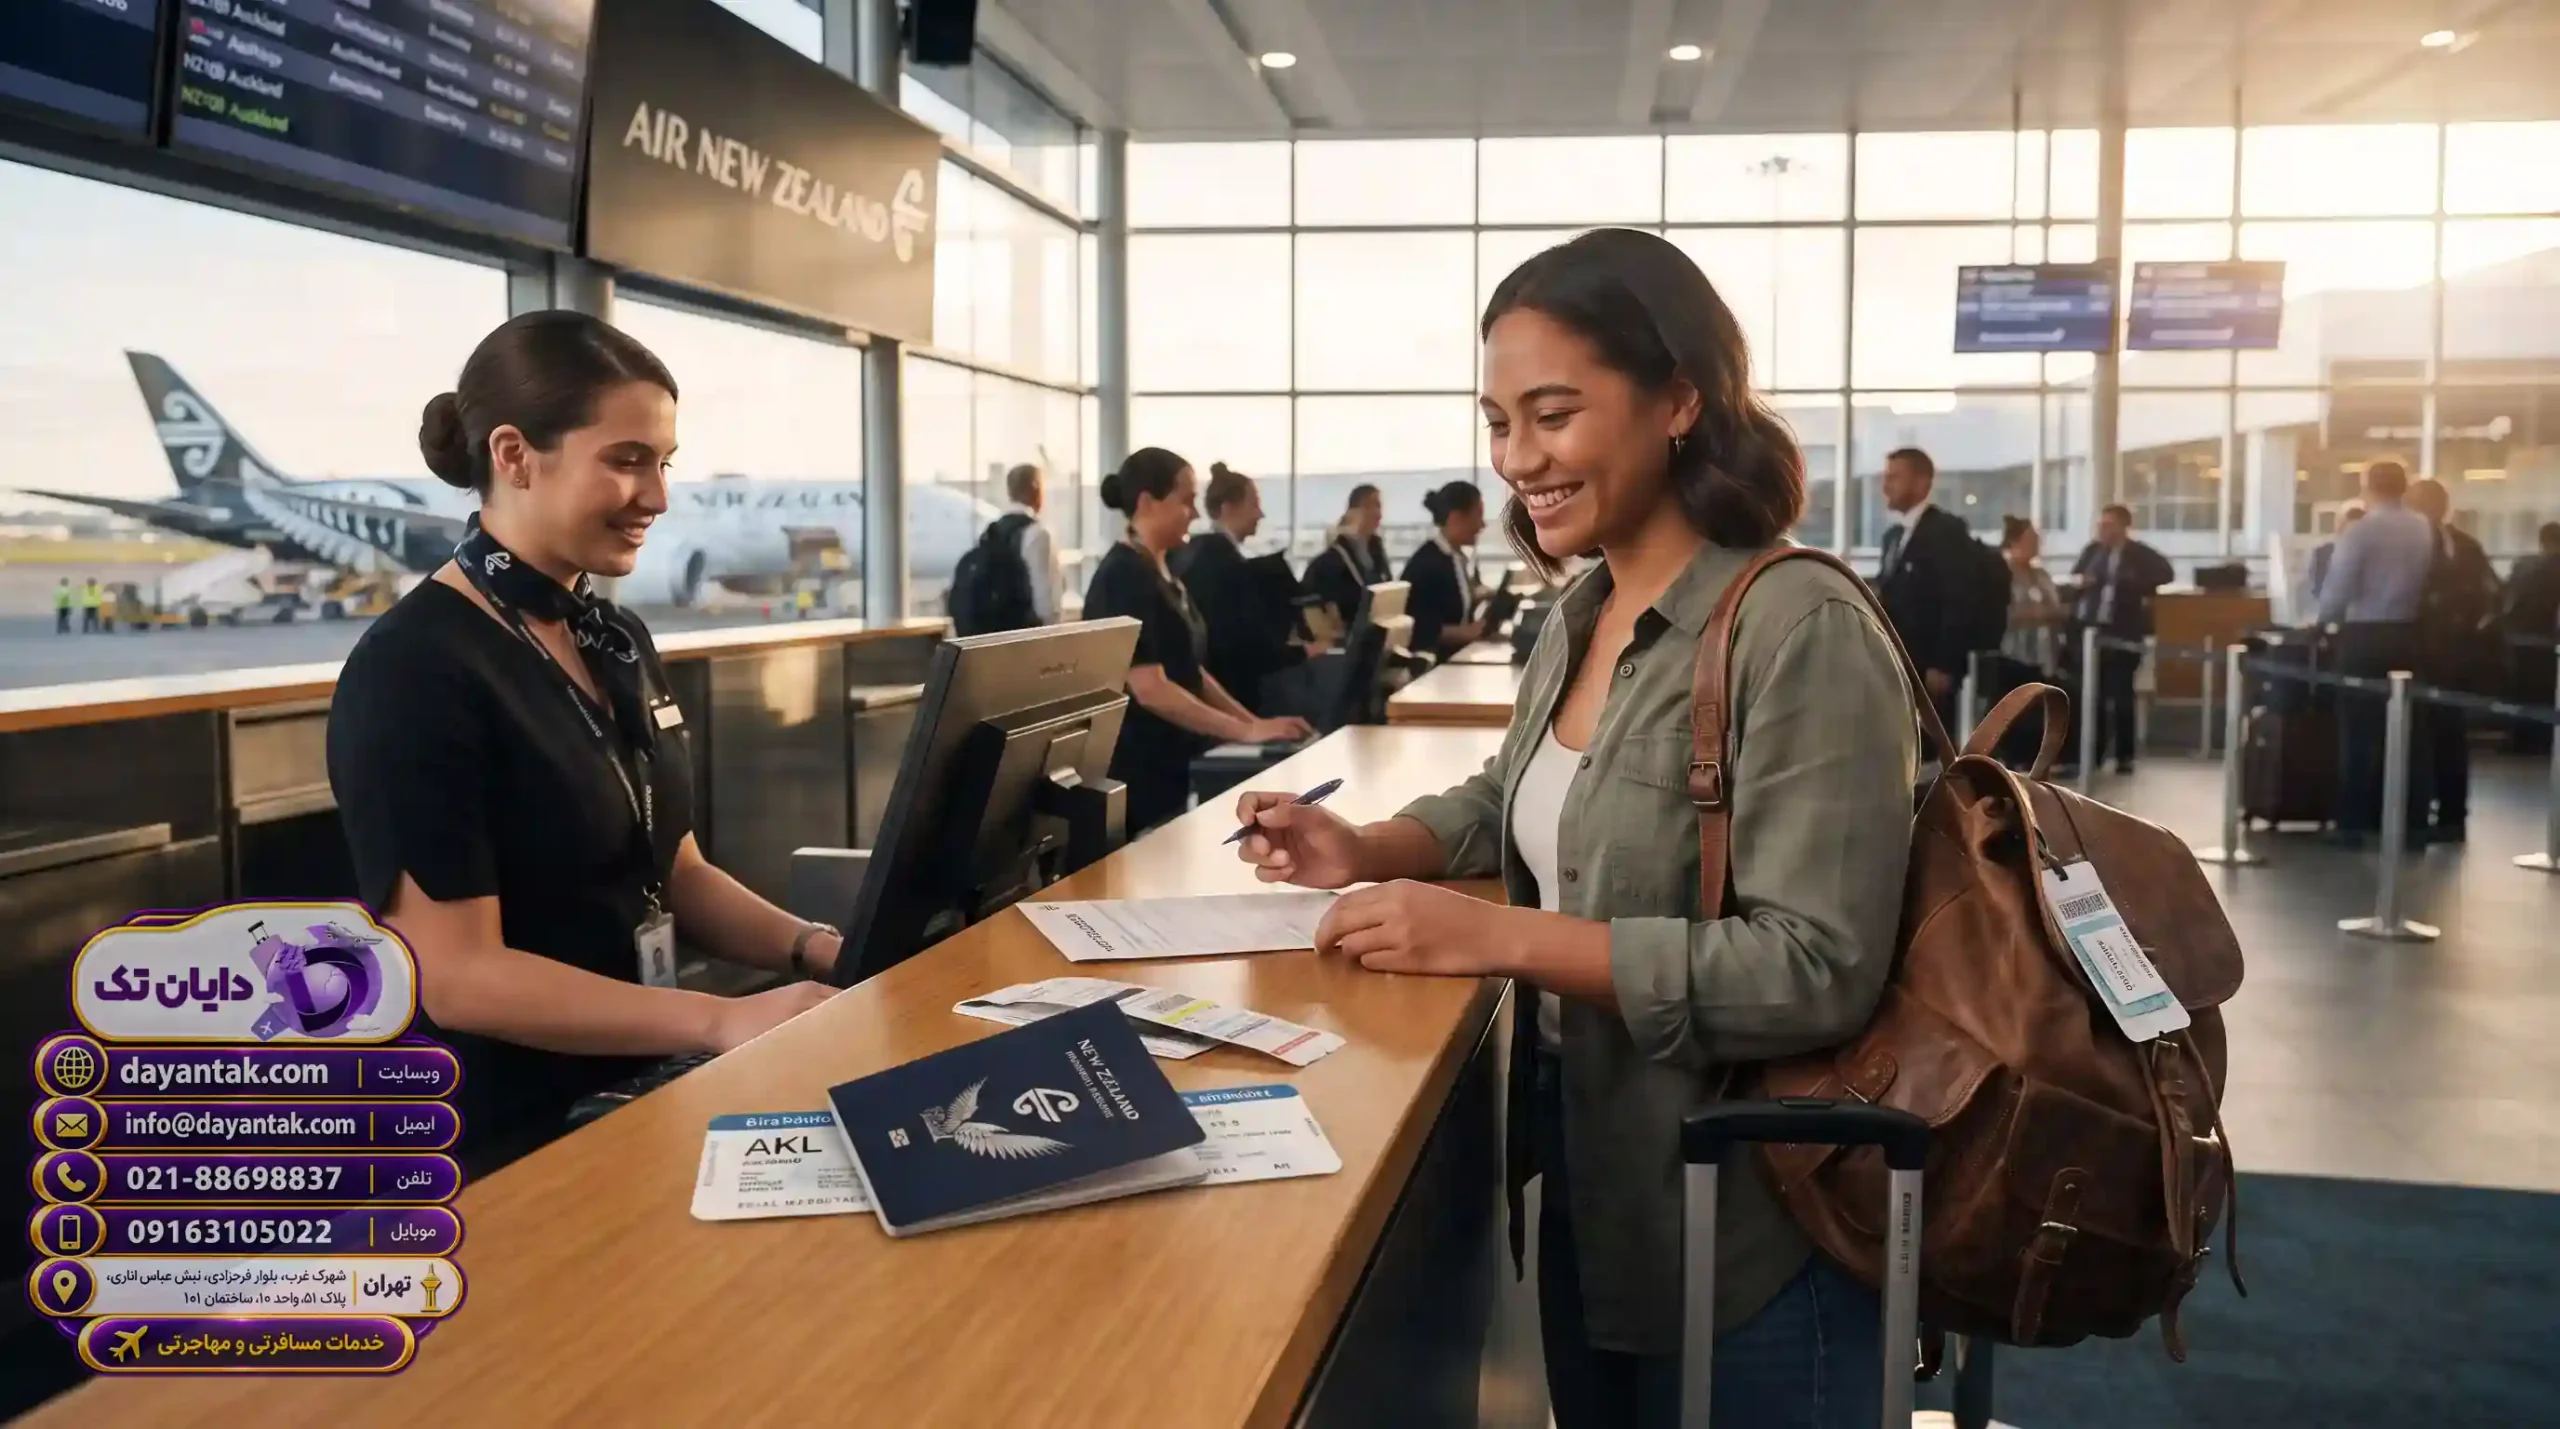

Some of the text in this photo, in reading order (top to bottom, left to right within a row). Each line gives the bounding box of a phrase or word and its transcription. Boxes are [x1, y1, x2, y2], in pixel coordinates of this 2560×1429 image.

[623, 101, 889, 242] AIR NEW ZEALAND
[1077, 1039, 1105, 1066] NEW
[744, 1136, 823, 1156] AKL
